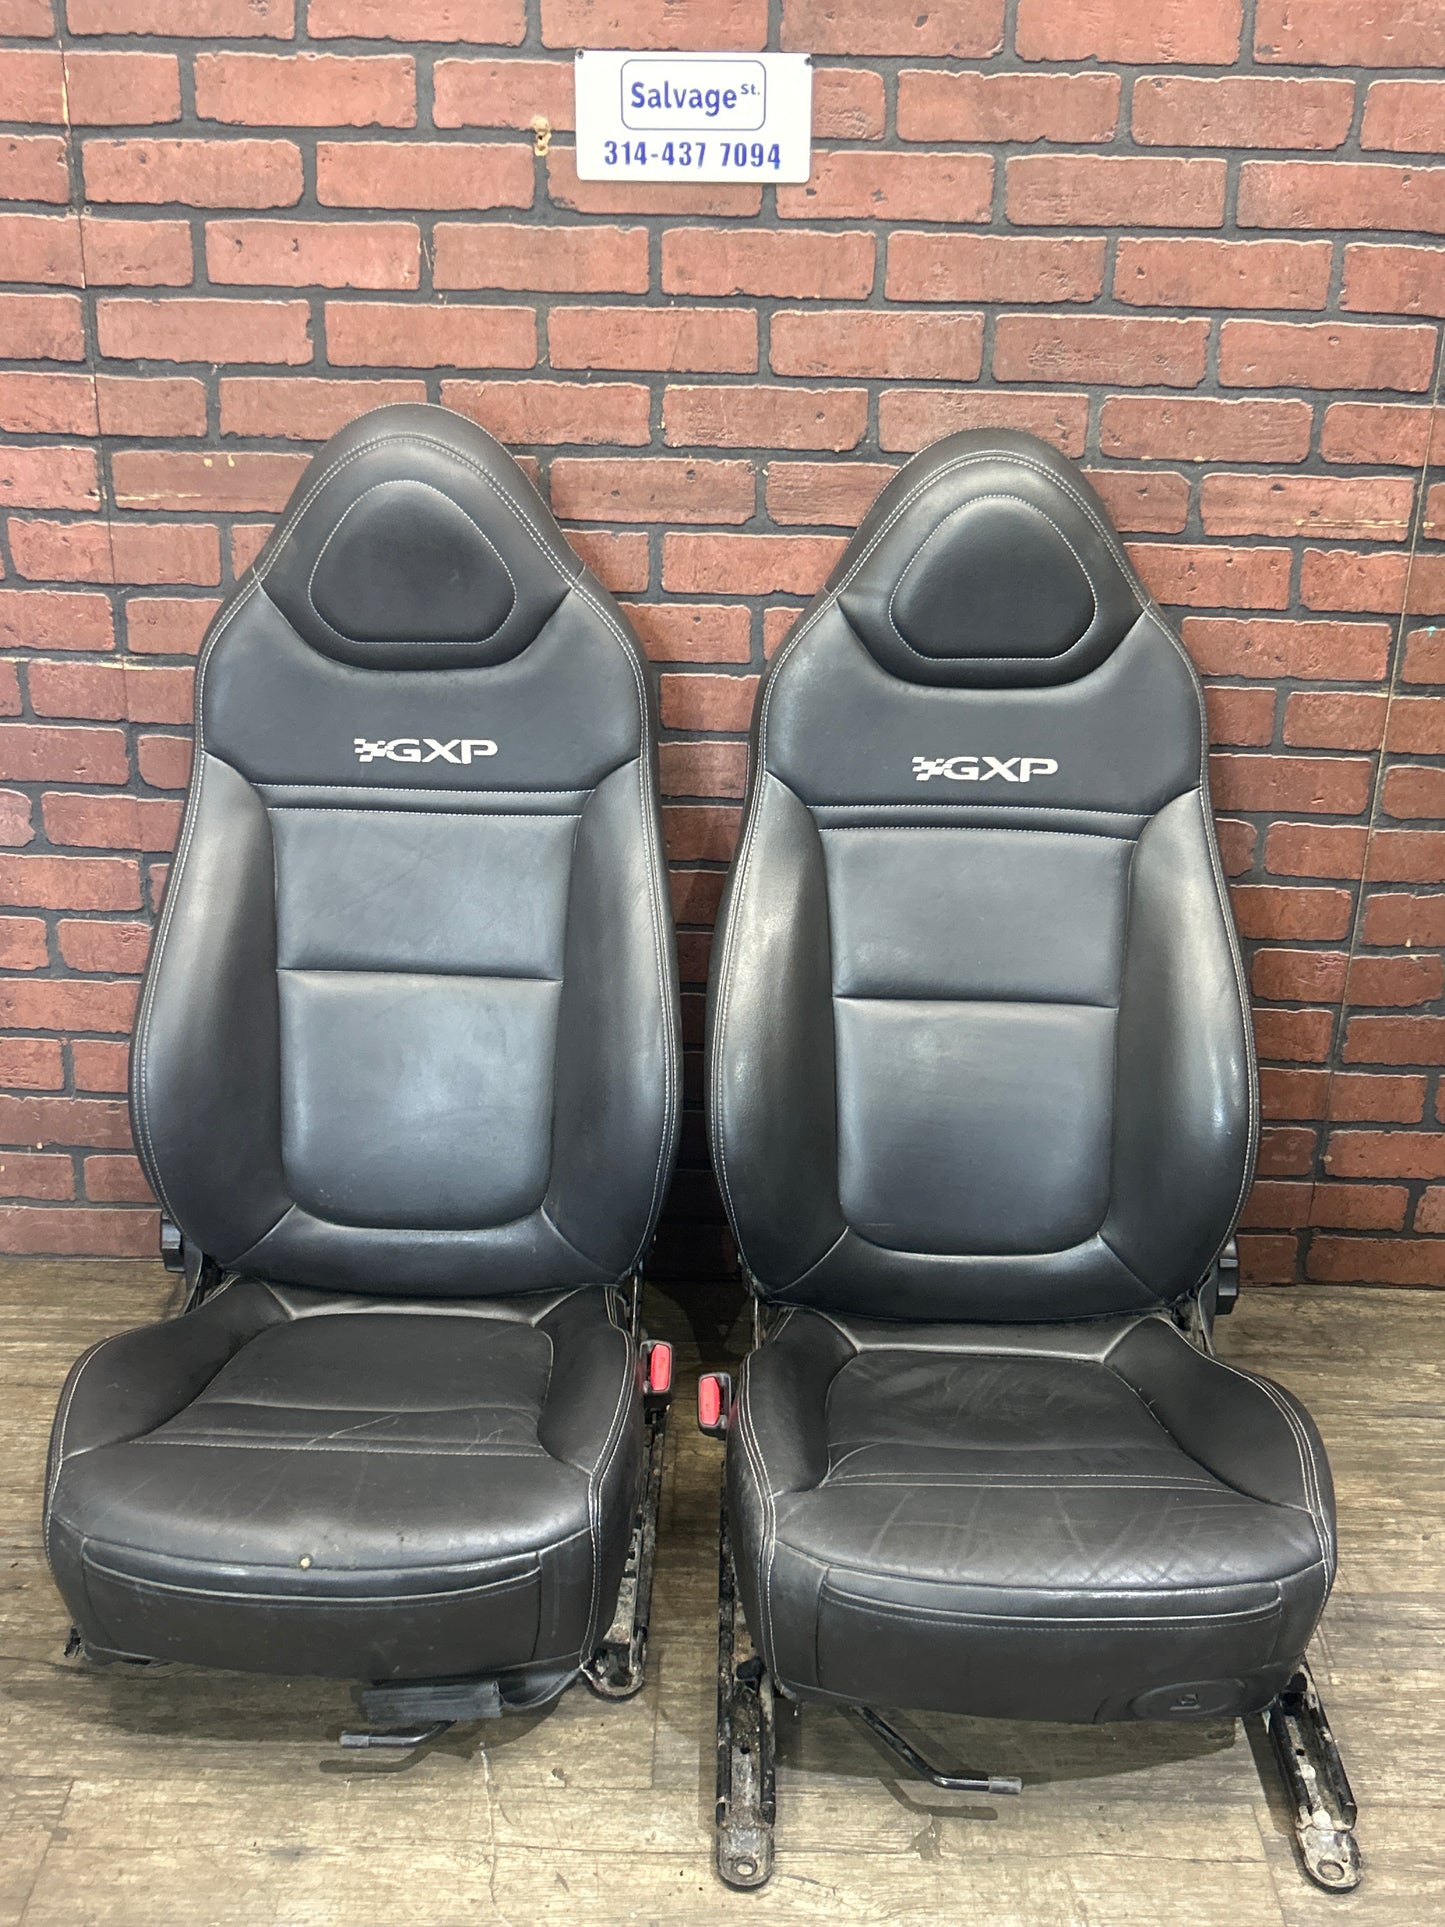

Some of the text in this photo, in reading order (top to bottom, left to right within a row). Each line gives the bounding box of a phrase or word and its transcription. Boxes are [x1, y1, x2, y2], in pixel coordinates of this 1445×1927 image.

[631, 80, 761, 117] Salvage St.
[604, 140, 781, 170] 314-437 7094
[386, 738, 498, 765] GXP
[943, 756, 1059, 783] GXP
